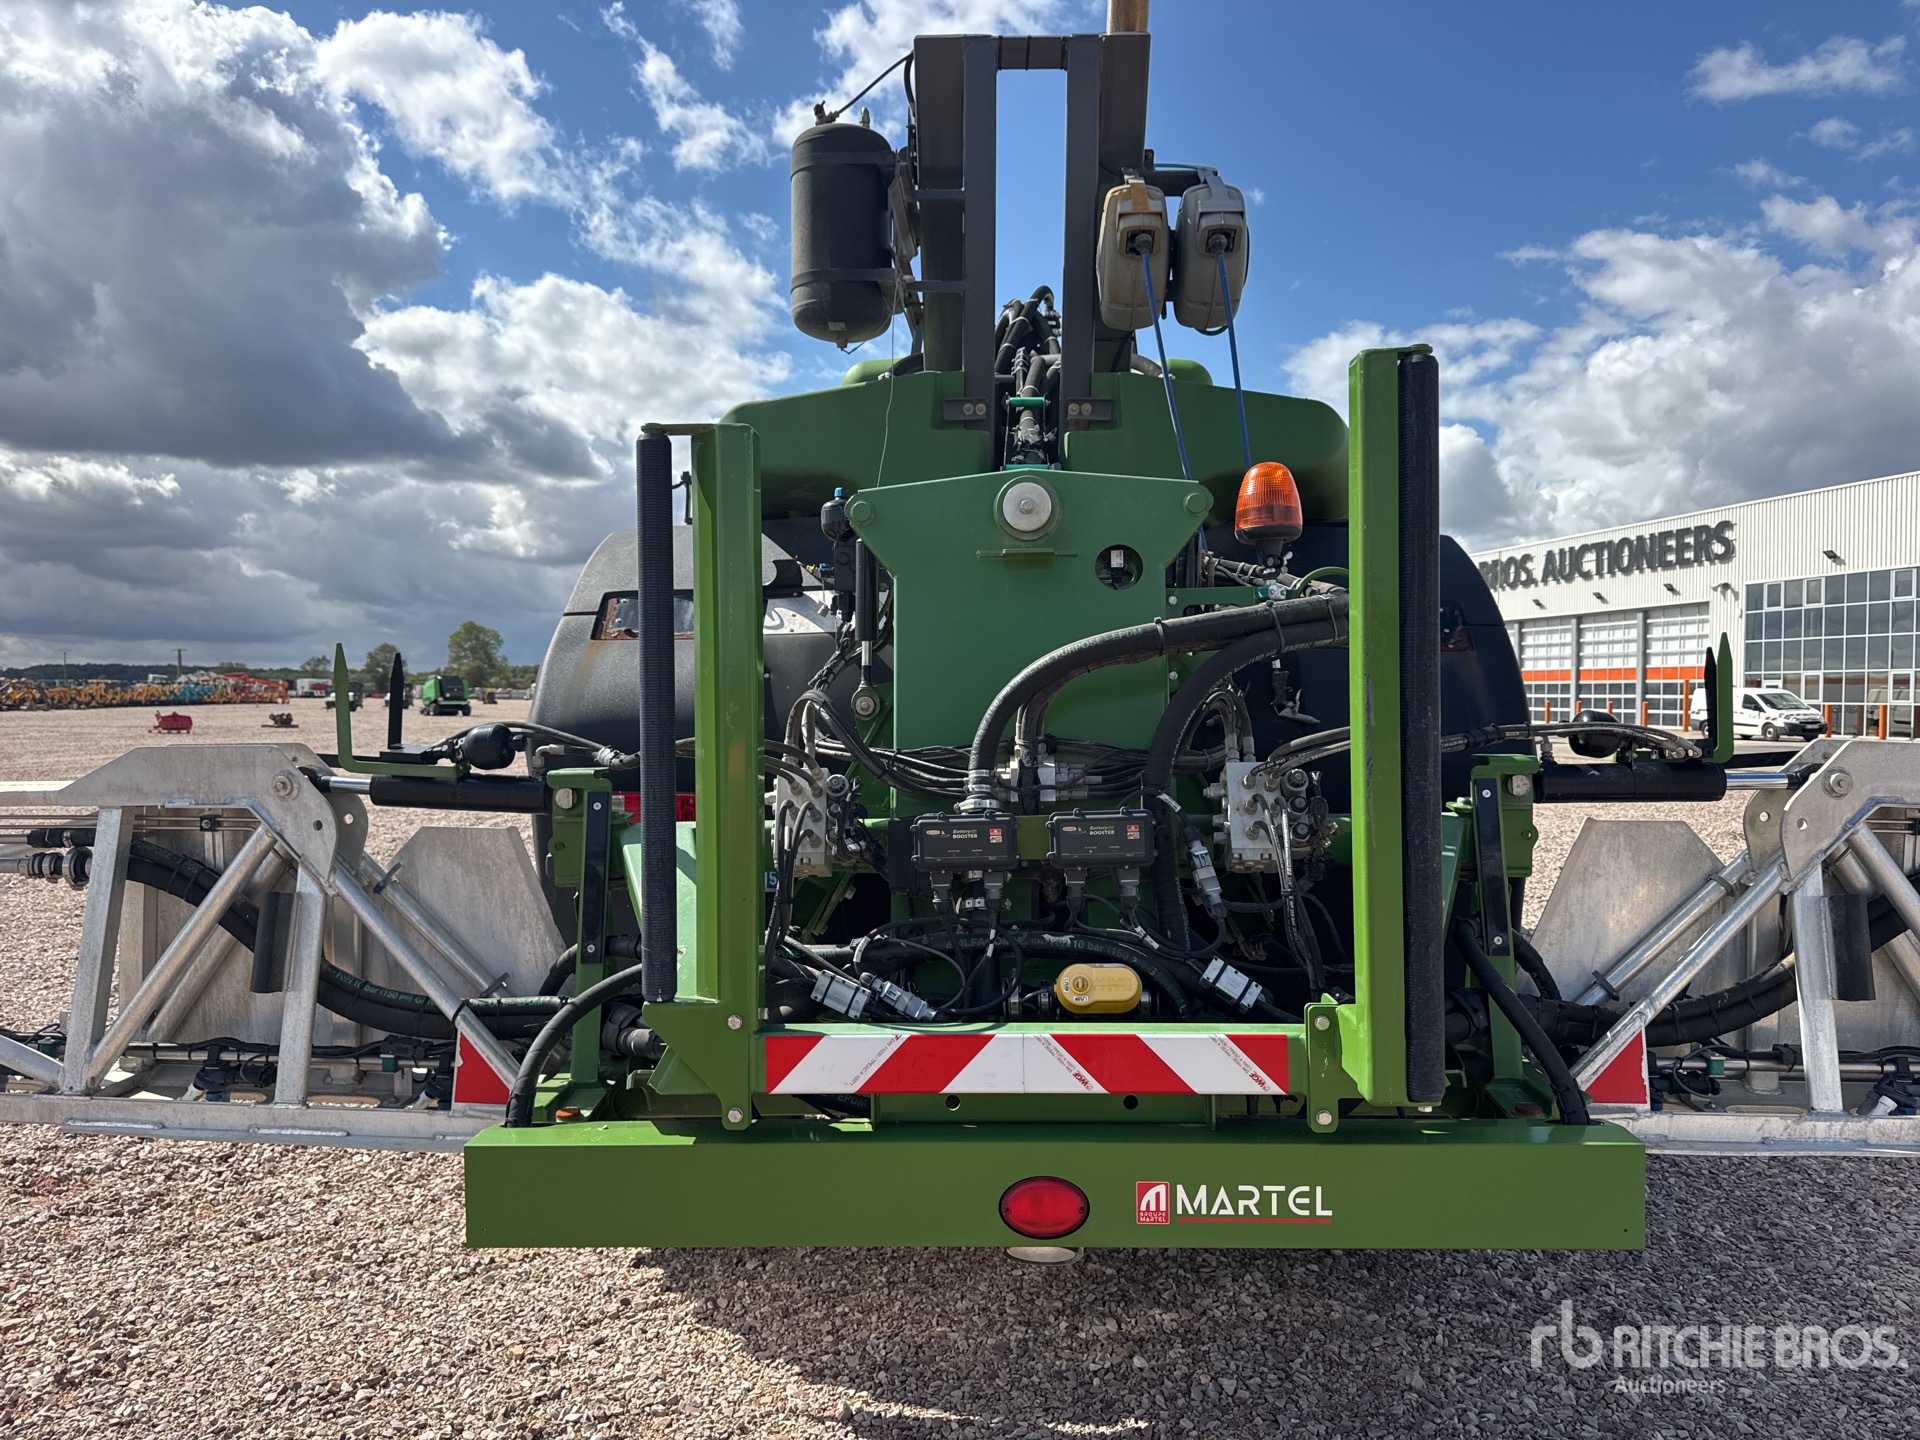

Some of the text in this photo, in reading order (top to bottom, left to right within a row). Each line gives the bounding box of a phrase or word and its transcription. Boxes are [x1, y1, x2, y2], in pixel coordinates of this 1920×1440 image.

[1541, 521, 1736, 584] AUCTIONEERS
[1053, 637, 1103, 661] PURPOSE
[1111, 627, 1143, 641] EPDM
[132, 840, 174, 860] PURPOSE
[1073, 938, 1085, 949] 10
[1088, 940, 1105, 952] bar
[363, 984, 379, 995] bar
[380, 987, 398, 1000] (150
[837, 1094, 868, 1108] EPDM
[1176, 1184, 1333, 1216] MARTEL
